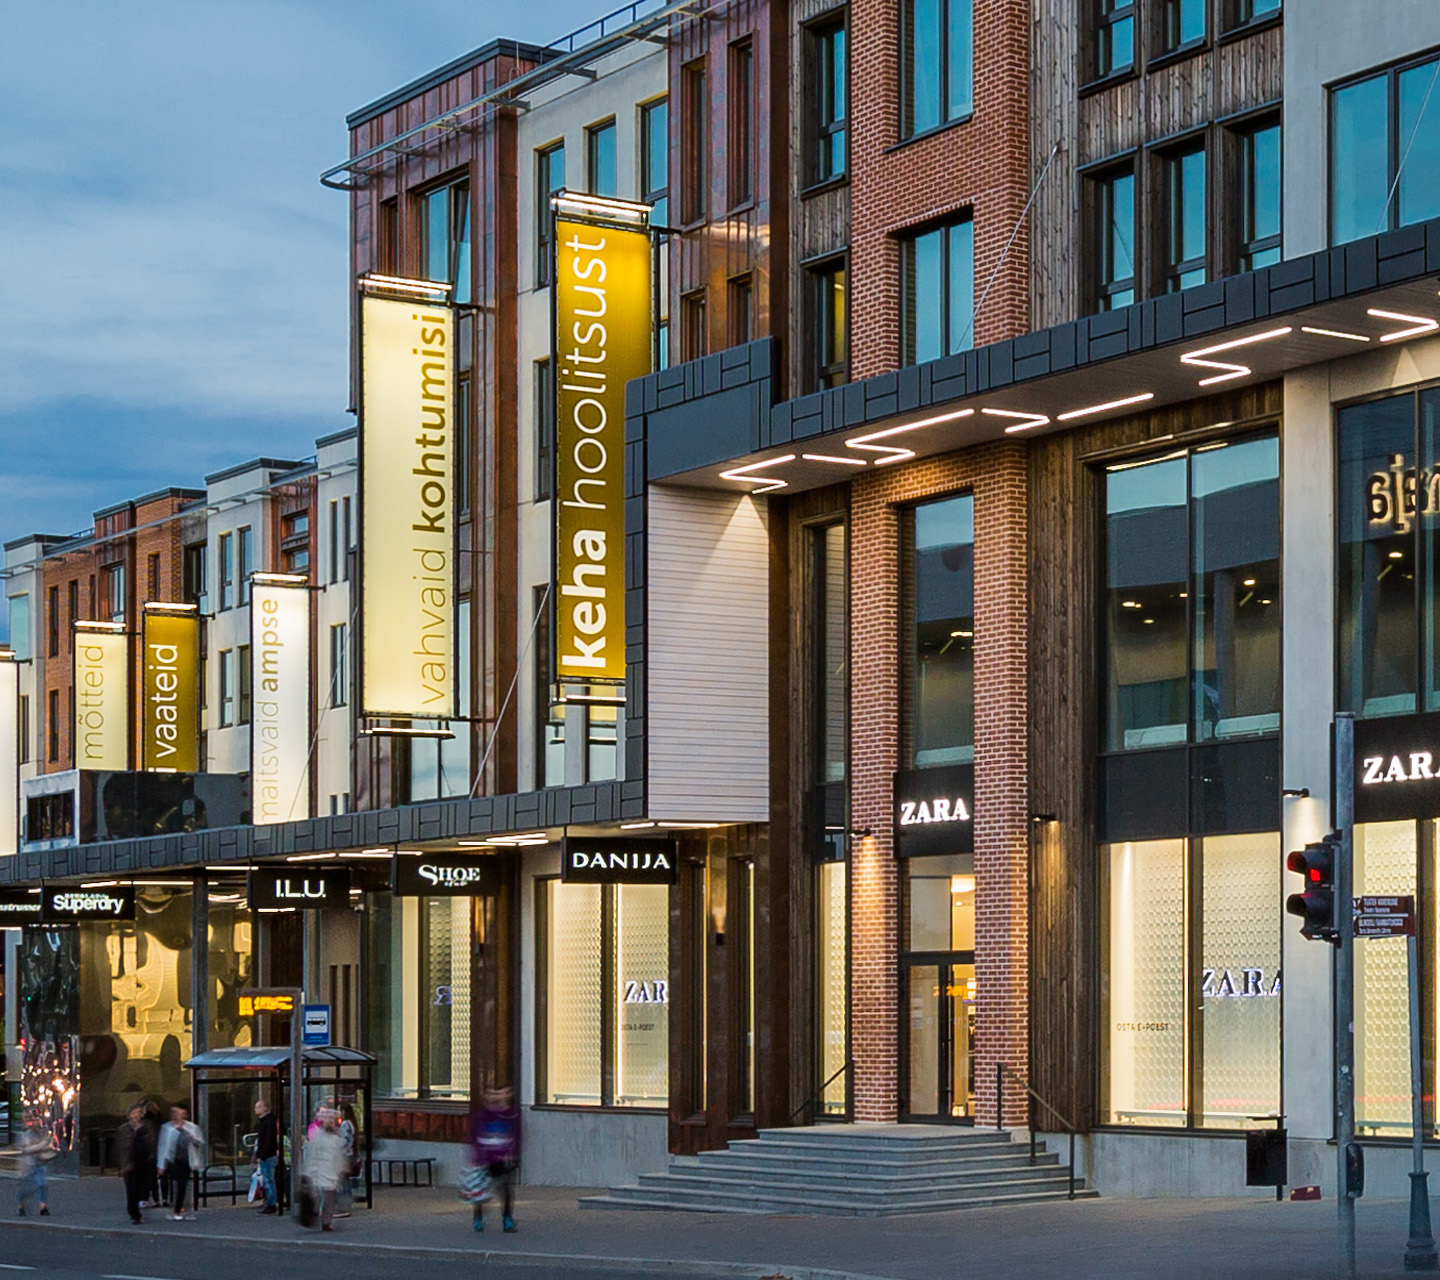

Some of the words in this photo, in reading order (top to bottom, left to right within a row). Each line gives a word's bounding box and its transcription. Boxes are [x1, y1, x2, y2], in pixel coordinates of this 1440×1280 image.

[412, 313, 447, 534] kohtumisi
[562, 233, 608, 510] hoolitsust
[260, 598, 282, 693] ampse
[414, 547, 446, 705] vahvaid
[562, 530, 606, 668] keha
[79, 644, 104, 759] mõtteid
[148, 643, 178, 759] vaateid
[257, 700, 279, 823] maitsvaid
[900, 797, 969, 826] ZARA
[53, 894, 124, 915] Superdry
[275, 879, 326, 898] I.L.U.
[572, 852, 671, 869] DANIJA
